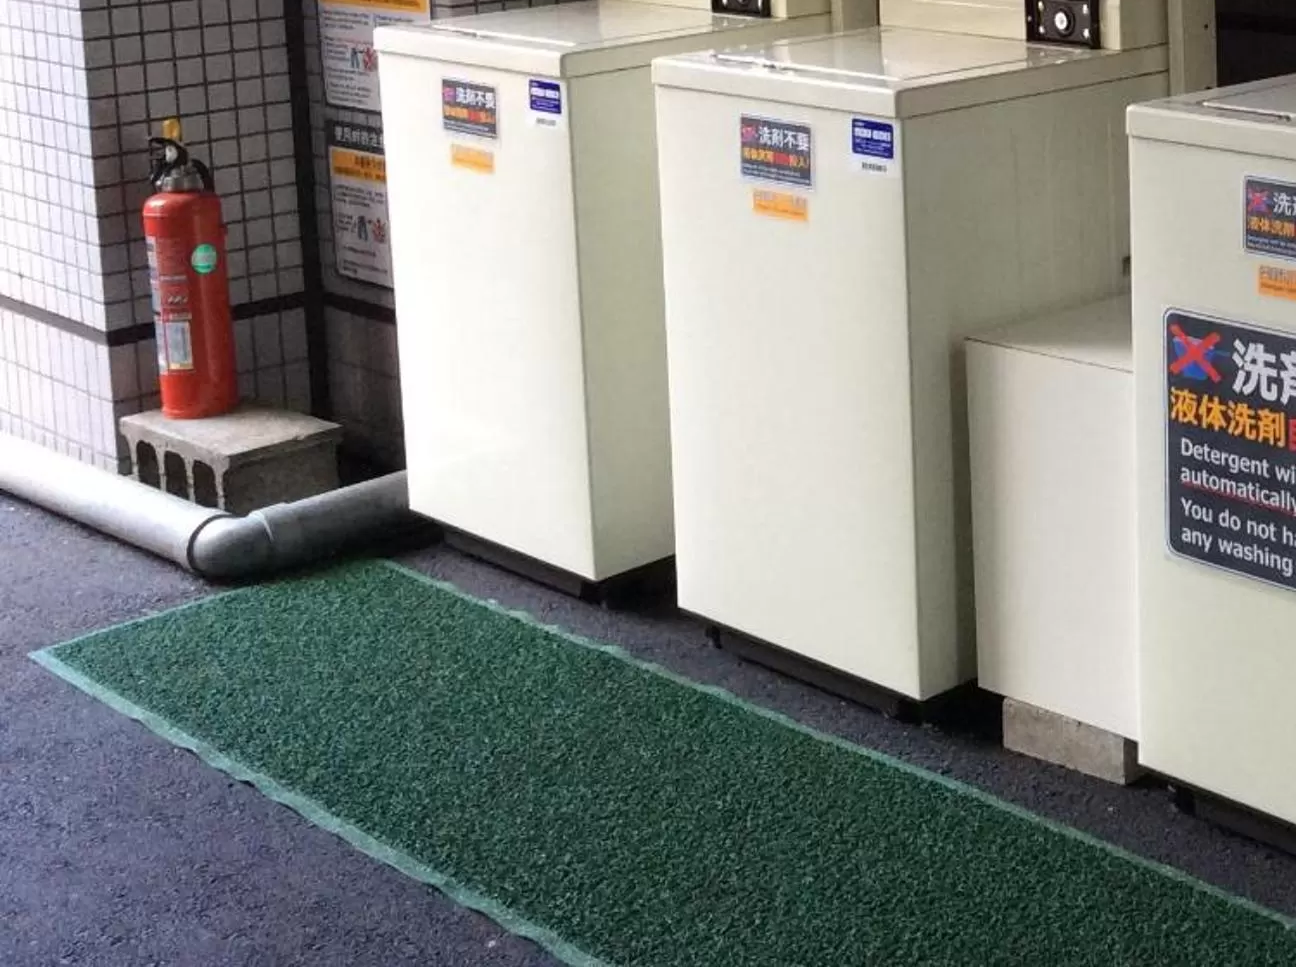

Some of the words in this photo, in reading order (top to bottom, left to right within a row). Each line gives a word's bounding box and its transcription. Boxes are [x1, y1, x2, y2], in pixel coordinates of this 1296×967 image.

[1181, 438, 1270, 478] Detergent
[1181, 498, 1213, 523] You
[1219, 507, 1241, 530] do
[1247, 519, 1277, 542] not
[1181, 528, 1212, 552] any
[1218, 535, 1293, 577] washing
